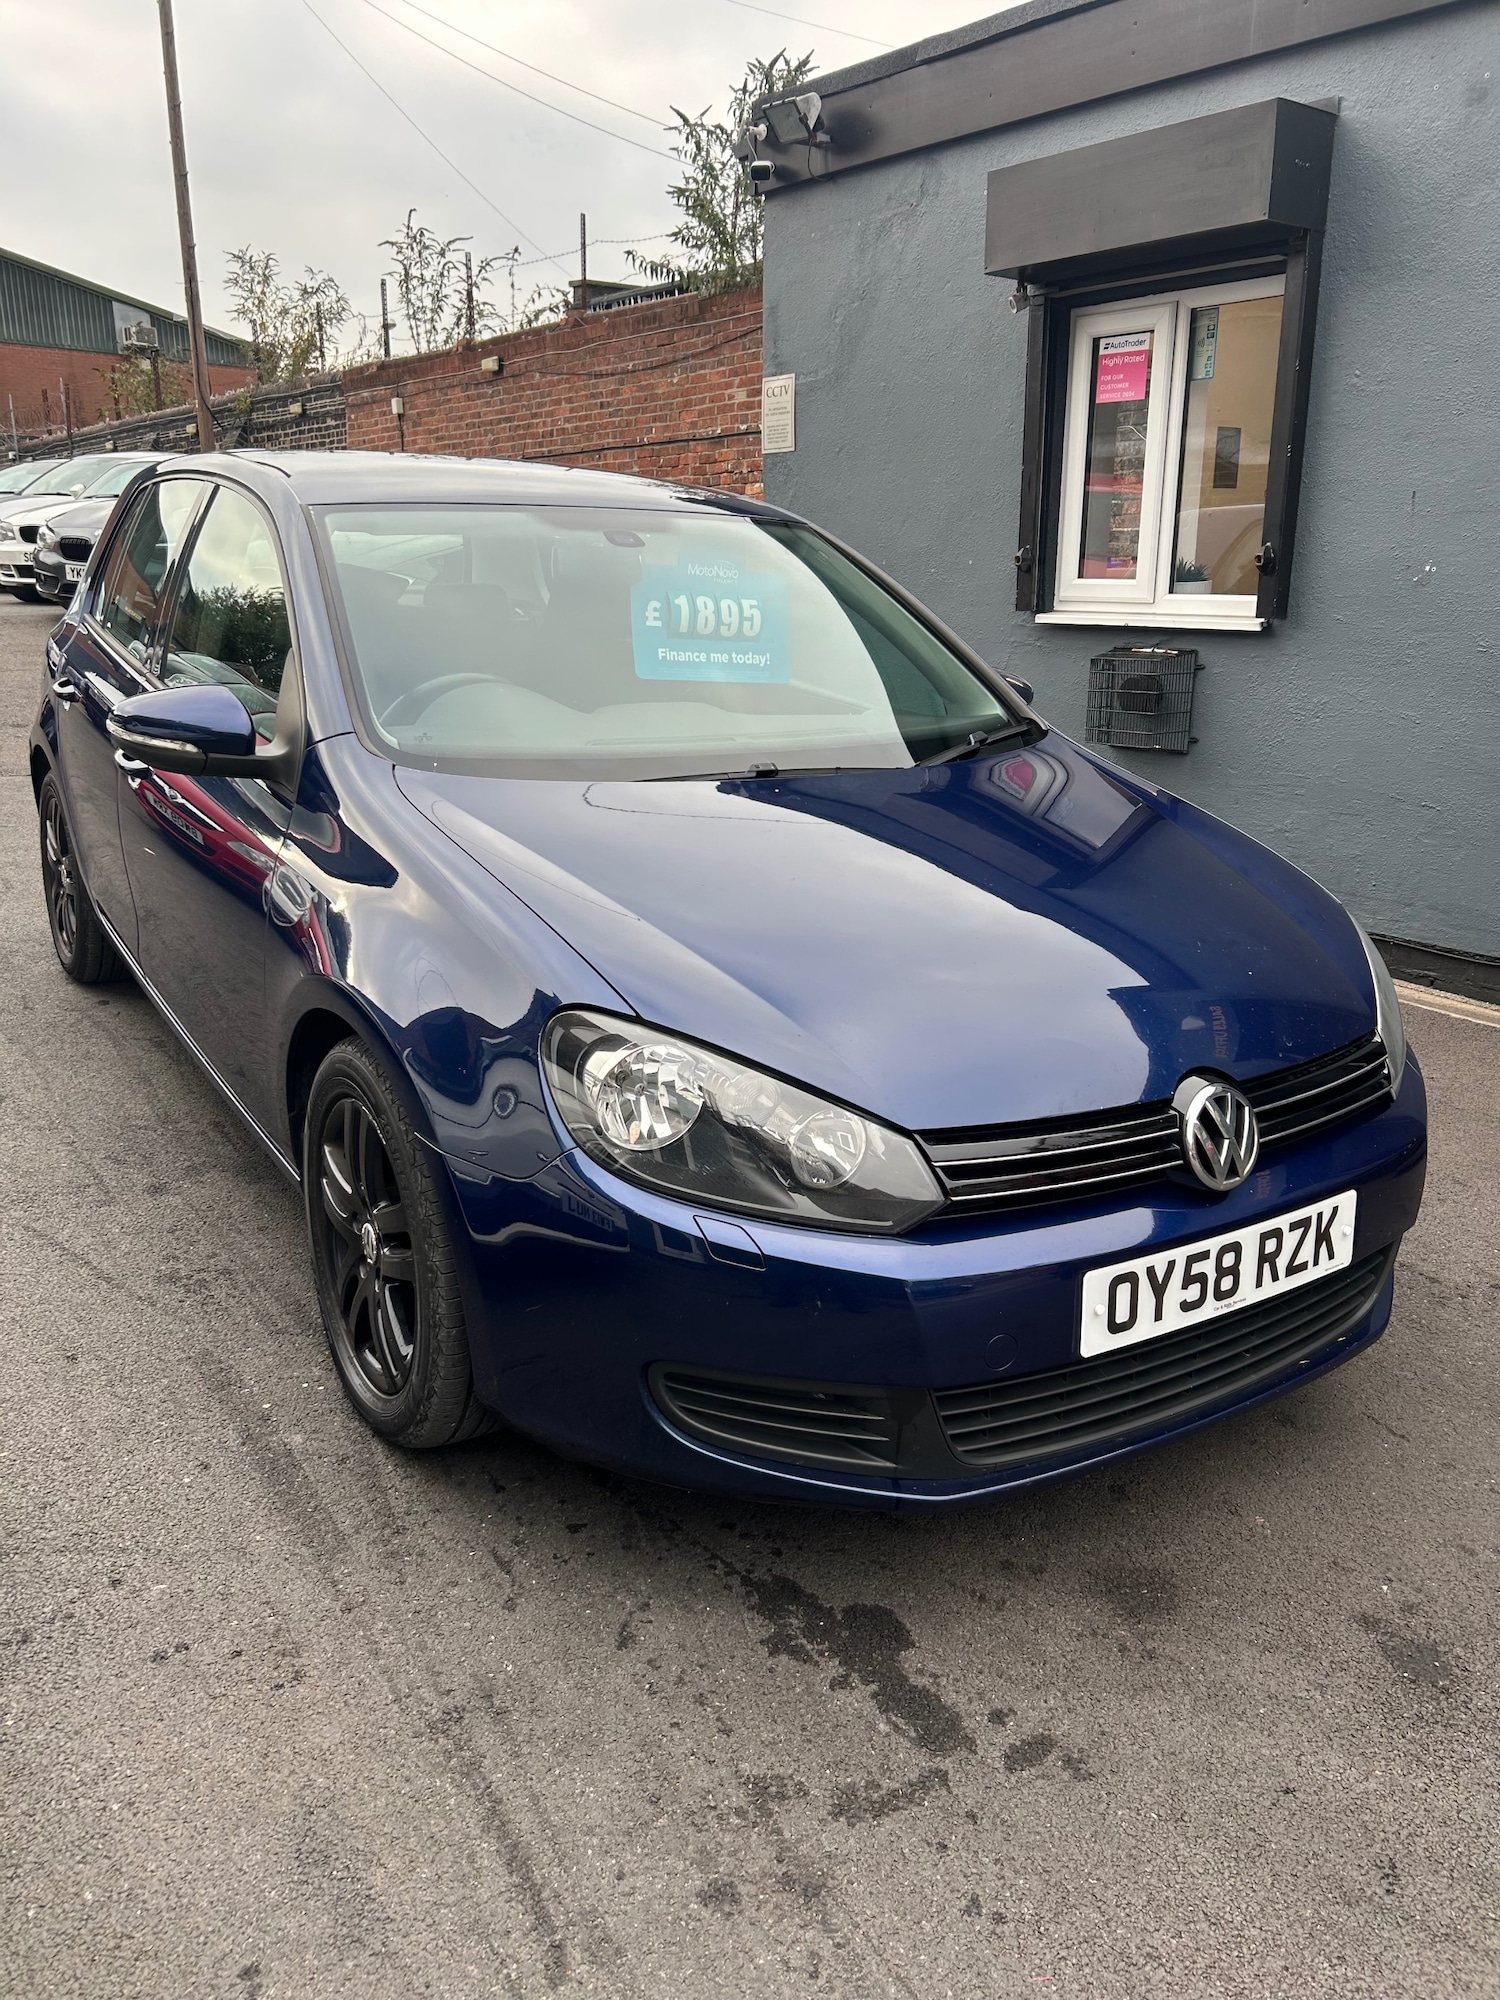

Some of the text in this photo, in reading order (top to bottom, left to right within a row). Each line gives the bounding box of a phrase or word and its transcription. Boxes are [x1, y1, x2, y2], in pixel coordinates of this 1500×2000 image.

[1110, 339, 1146, 349] AutoTrader
[1102, 353, 1145, 367] Highly Rated
[766, 384, 790, 398] CCTV
[1100, 382, 1129, 390] CUSTOMER
[1100, 391, 1121, 399] SERVICE
[687, 563, 739, 579] MotoNovo
[674, 594, 762, 637] 1895
[658, 648, 771, 666] Finance me today!
[1107, 1205, 1339, 1335] OY58 RZK
